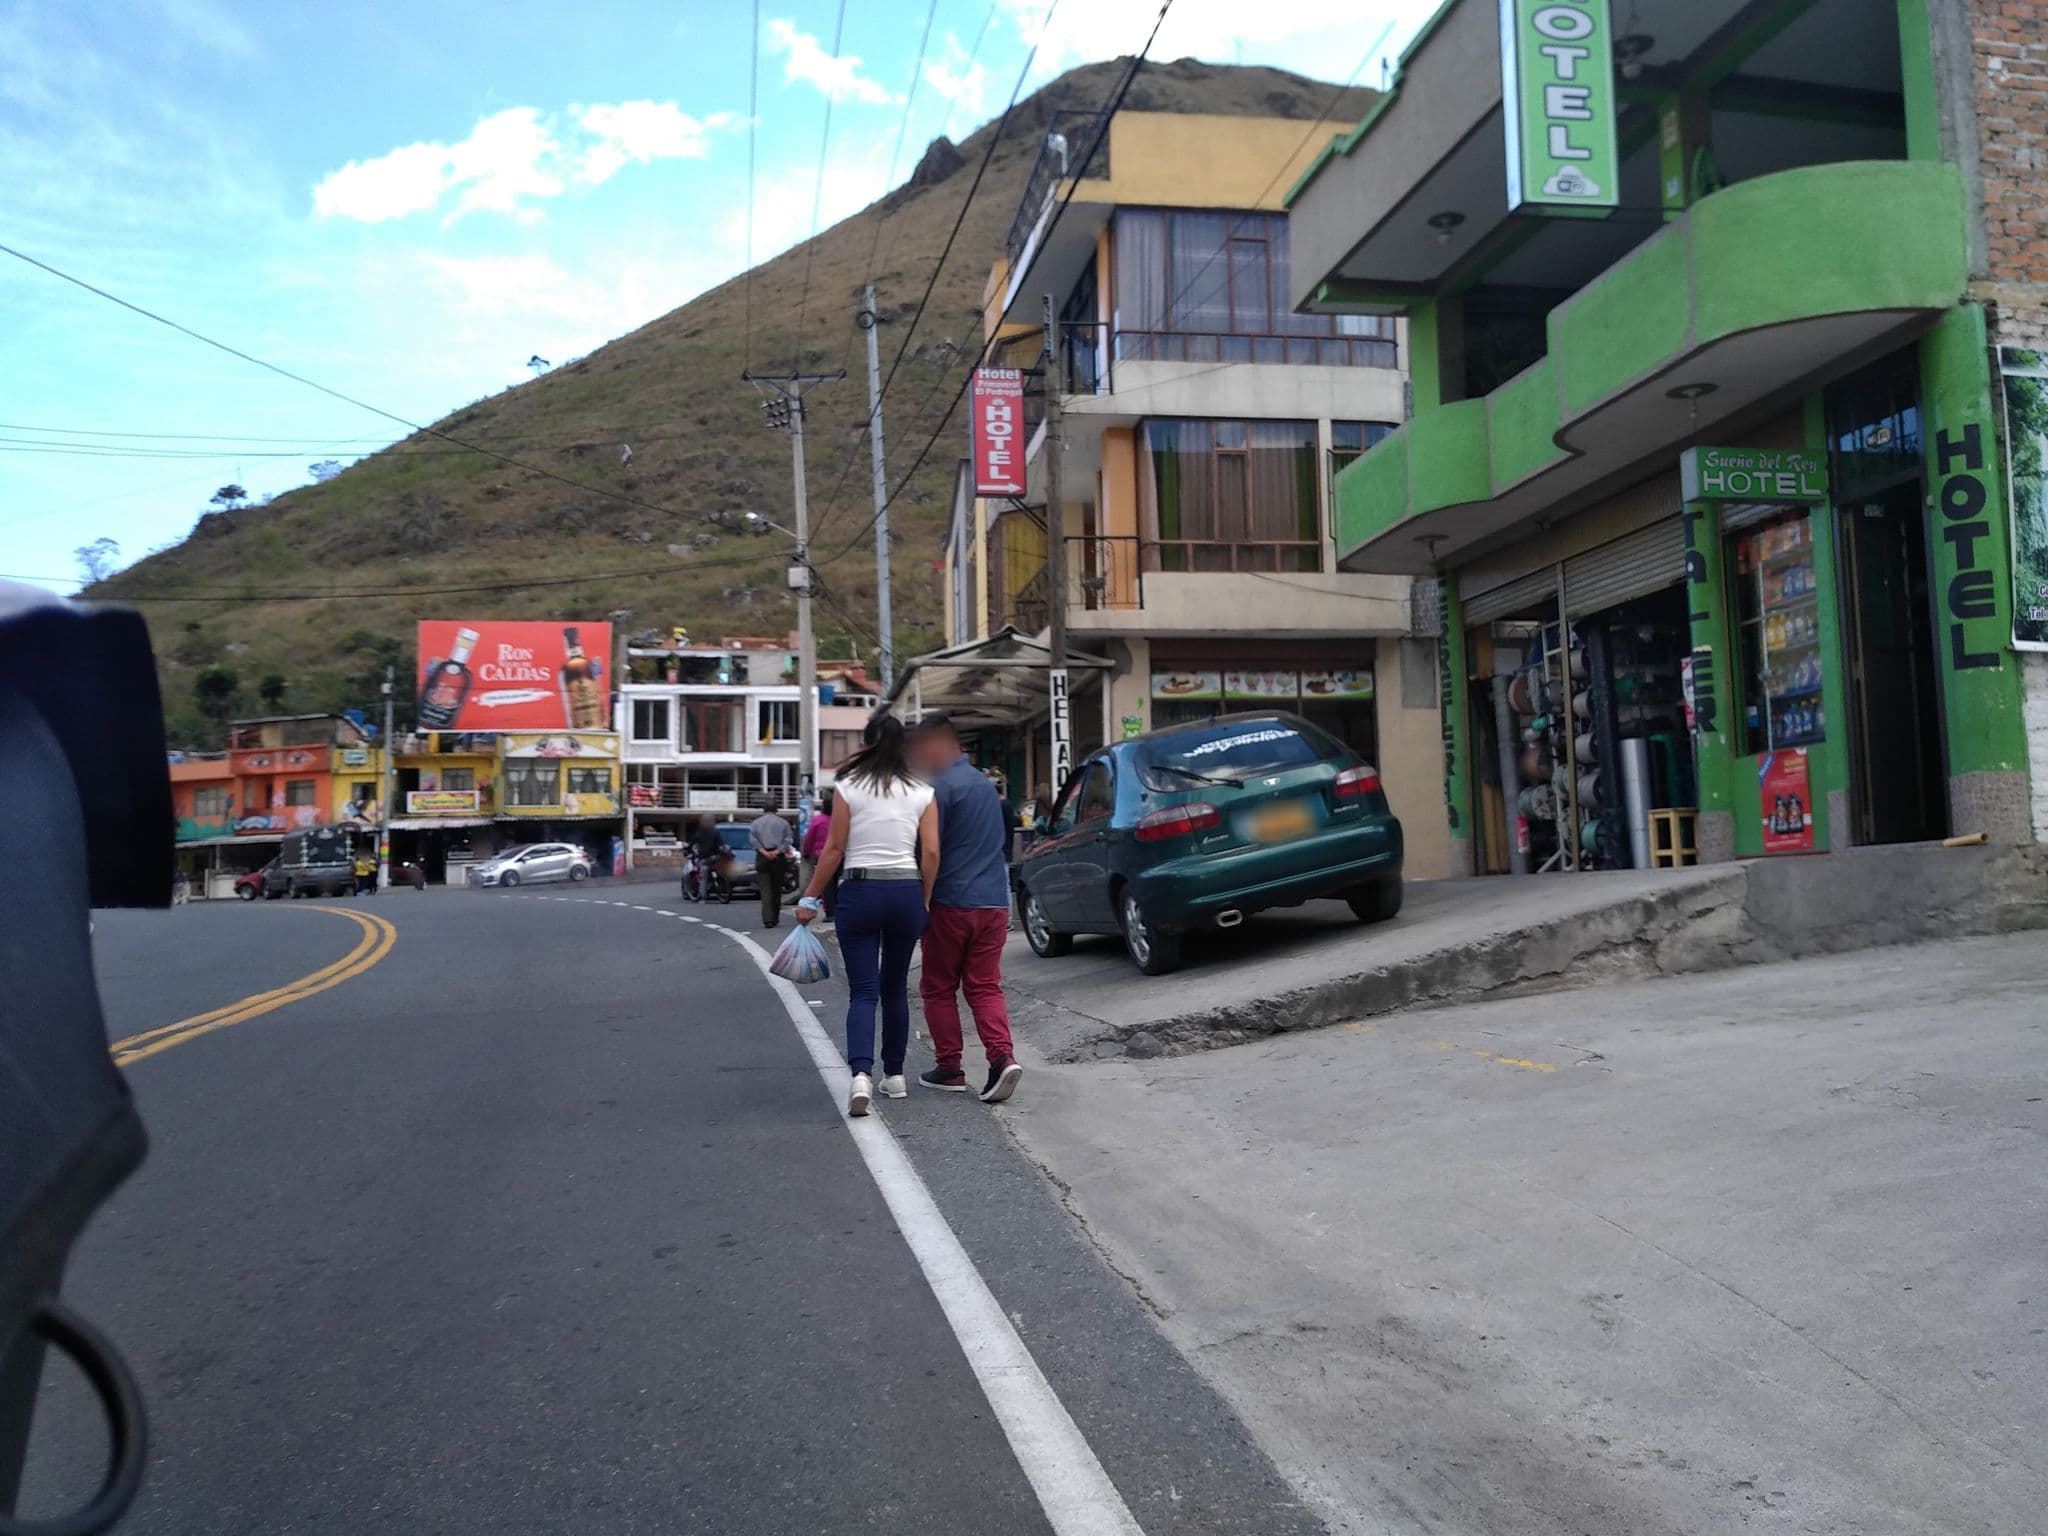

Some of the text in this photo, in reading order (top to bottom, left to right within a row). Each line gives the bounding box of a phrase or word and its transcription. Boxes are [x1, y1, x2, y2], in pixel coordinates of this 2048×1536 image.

[1532, 0, 1595, 160] OTEL
[978, 369, 1020, 380] Hotel
[985, 405, 1013, 480] HOTEL
[1705, 451, 1818, 475] Sueño del Rey
[1703, 470, 1822, 496] HOTEL
[1935, 423, 2001, 671] HOTEL
[480, 663, 551, 682] CALDAS
[1052, 675, 1070, 803] HELAD
